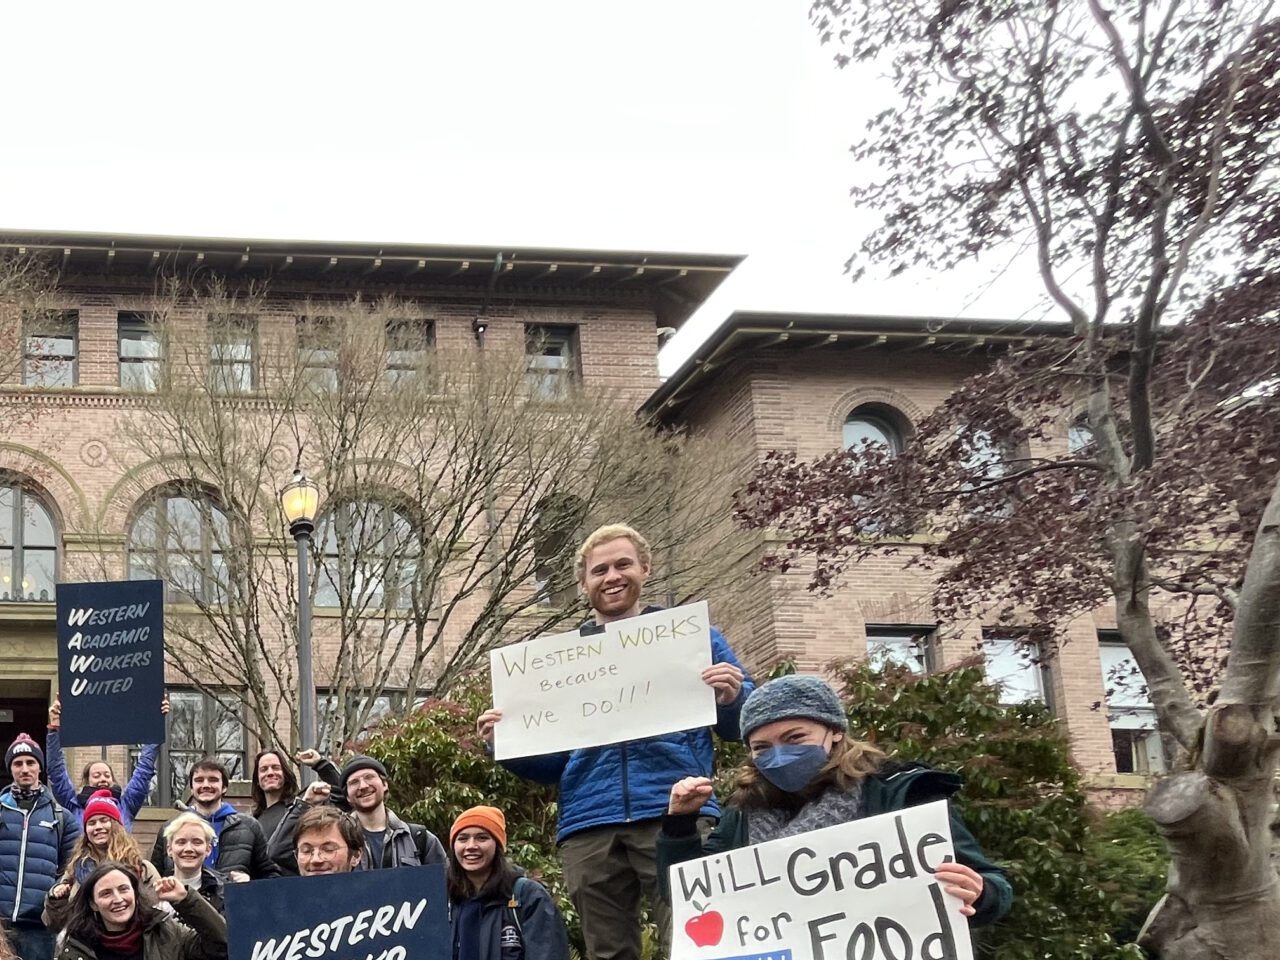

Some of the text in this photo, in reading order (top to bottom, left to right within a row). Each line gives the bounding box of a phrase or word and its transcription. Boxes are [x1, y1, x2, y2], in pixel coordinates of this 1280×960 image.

[67, 600, 150, 627] WESTERN
[67, 626, 150, 650] ACADEMIC
[618, 615, 702, 649] WORKS
[69, 651, 152, 674] WORKERS
[70, 677, 134, 697] UNITED
[540, 664, 619, 692] Because
[523, 710, 560, 729] We
[787, 815, 953, 897] Grade
[736, 911, 792, 946] for
